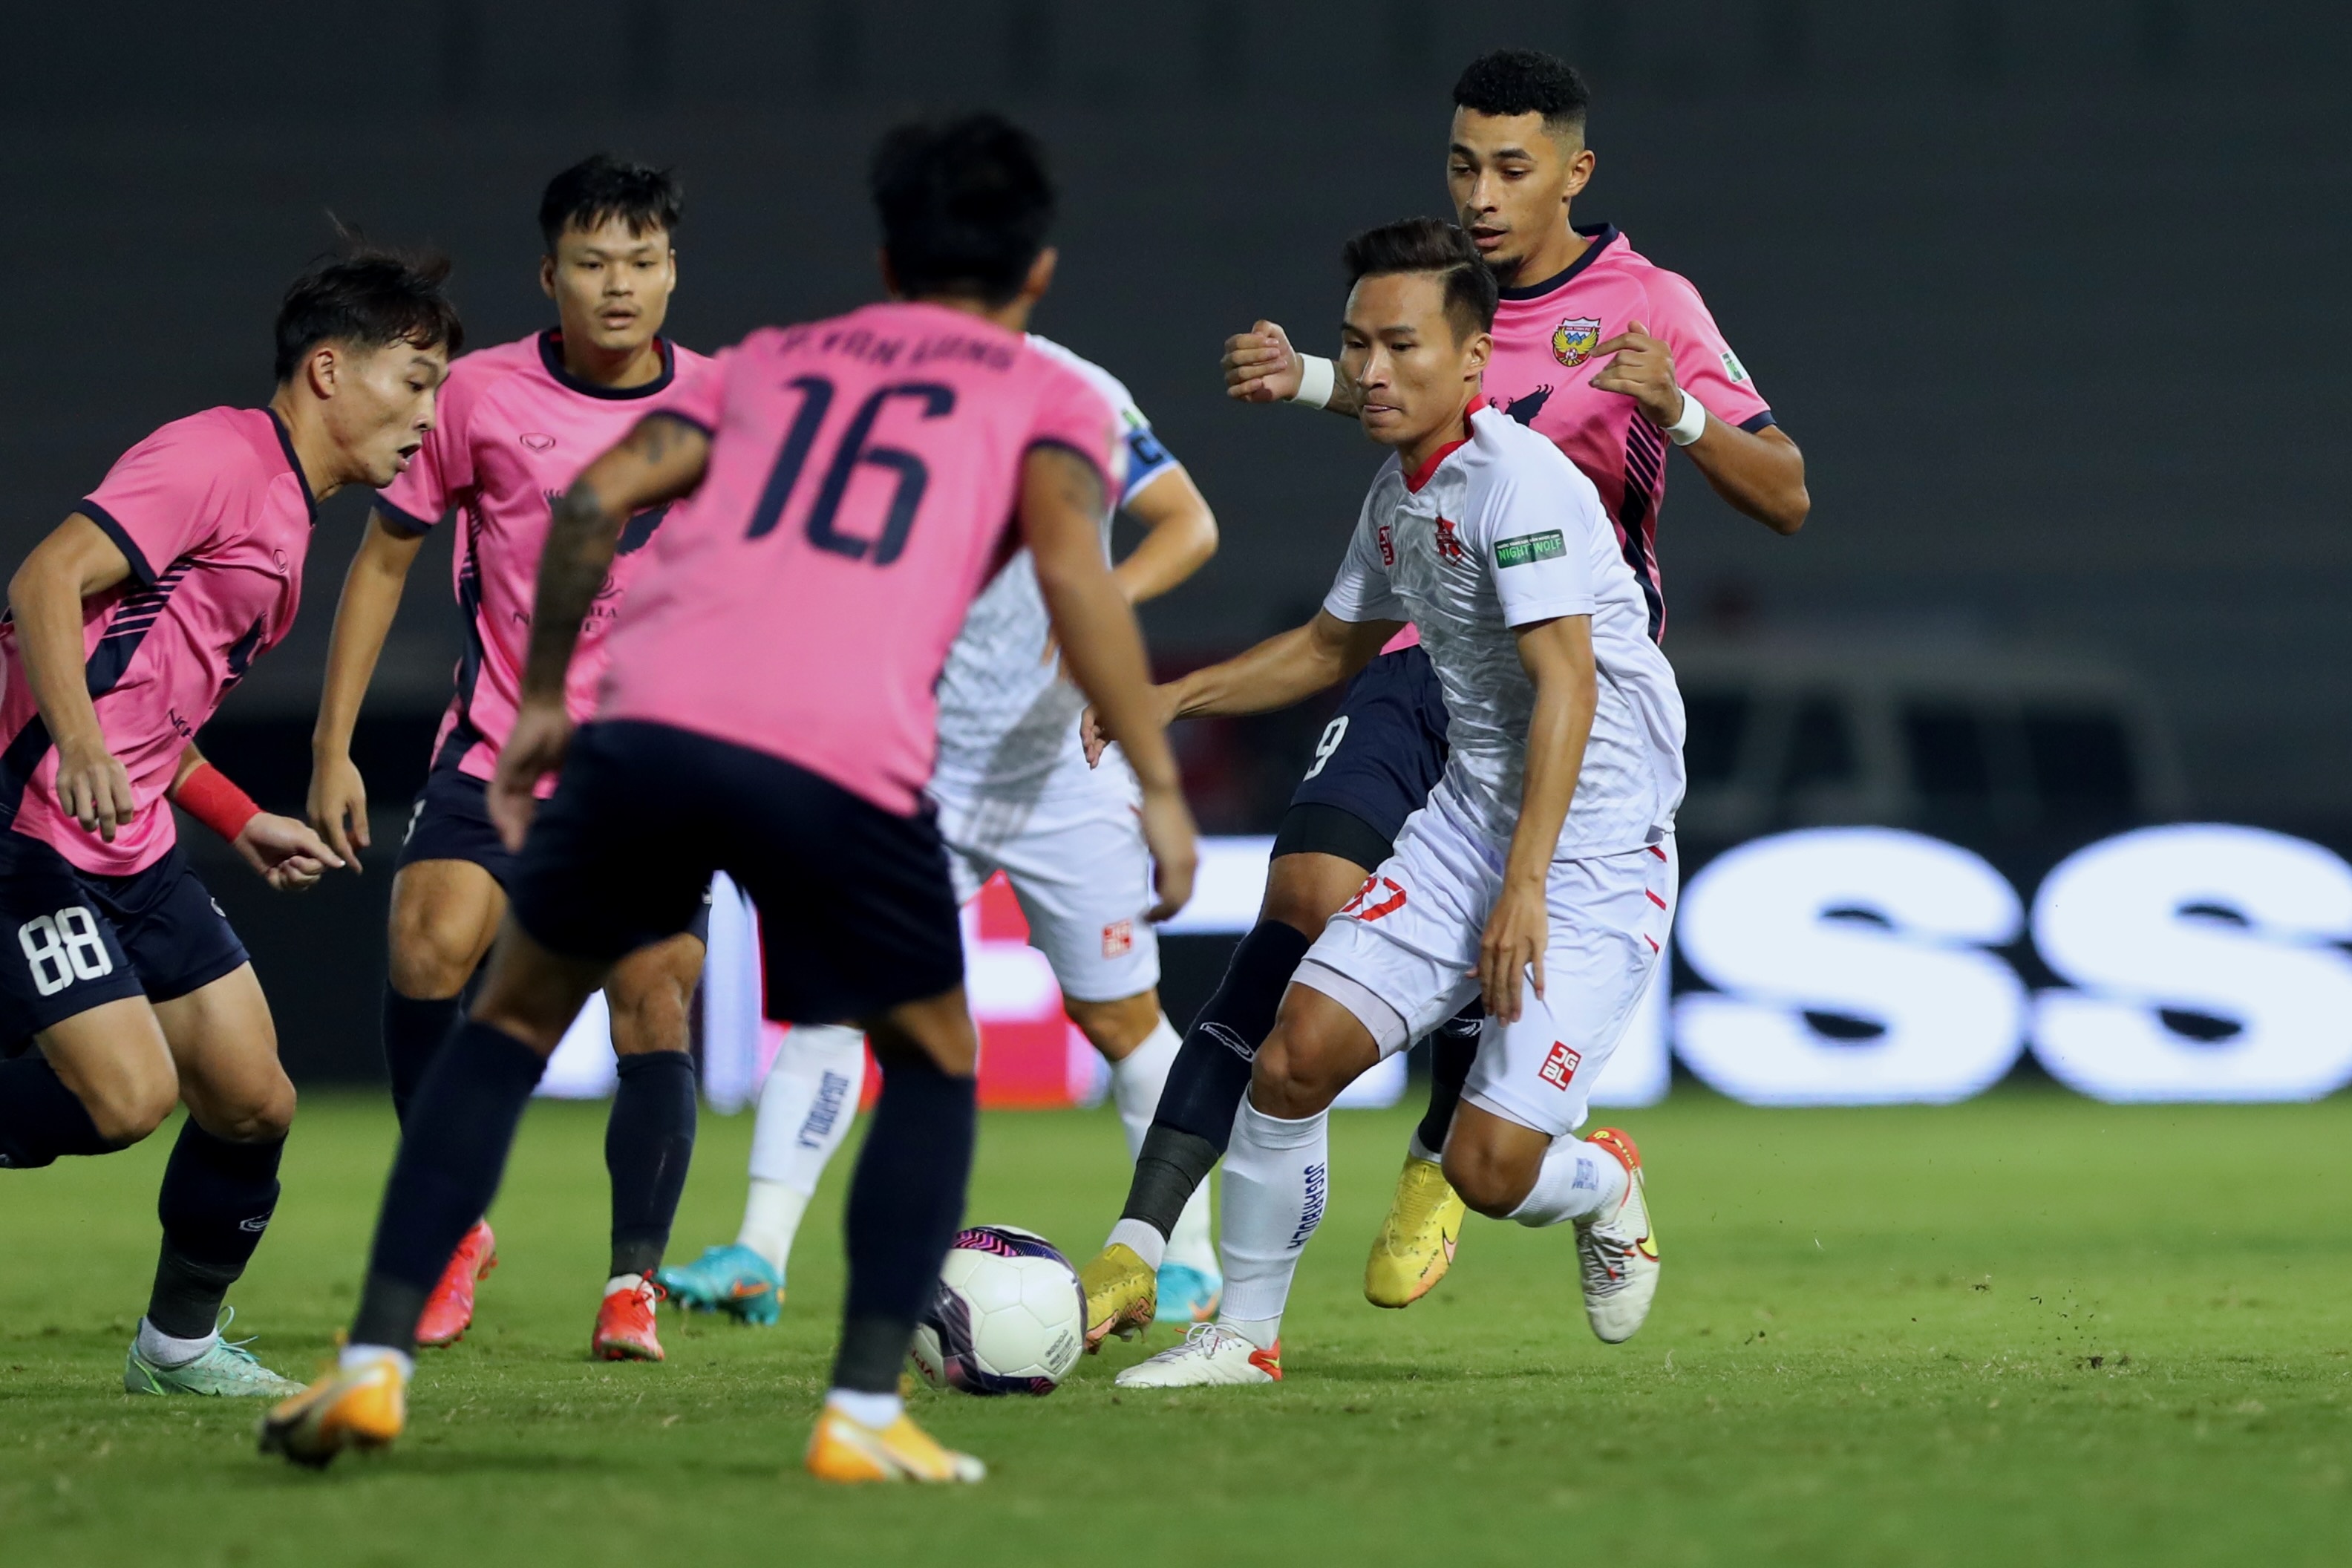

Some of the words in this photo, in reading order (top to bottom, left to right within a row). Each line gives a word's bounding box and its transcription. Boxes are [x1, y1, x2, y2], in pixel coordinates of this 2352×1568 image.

[743, 373, 956, 567] 16
[1497, 543, 1531, 561] NIGHT
[1533, 538, 1562, 553] WOLF
[1303, 715, 1349, 782] 9
[18, 906, 113, 996] 88
